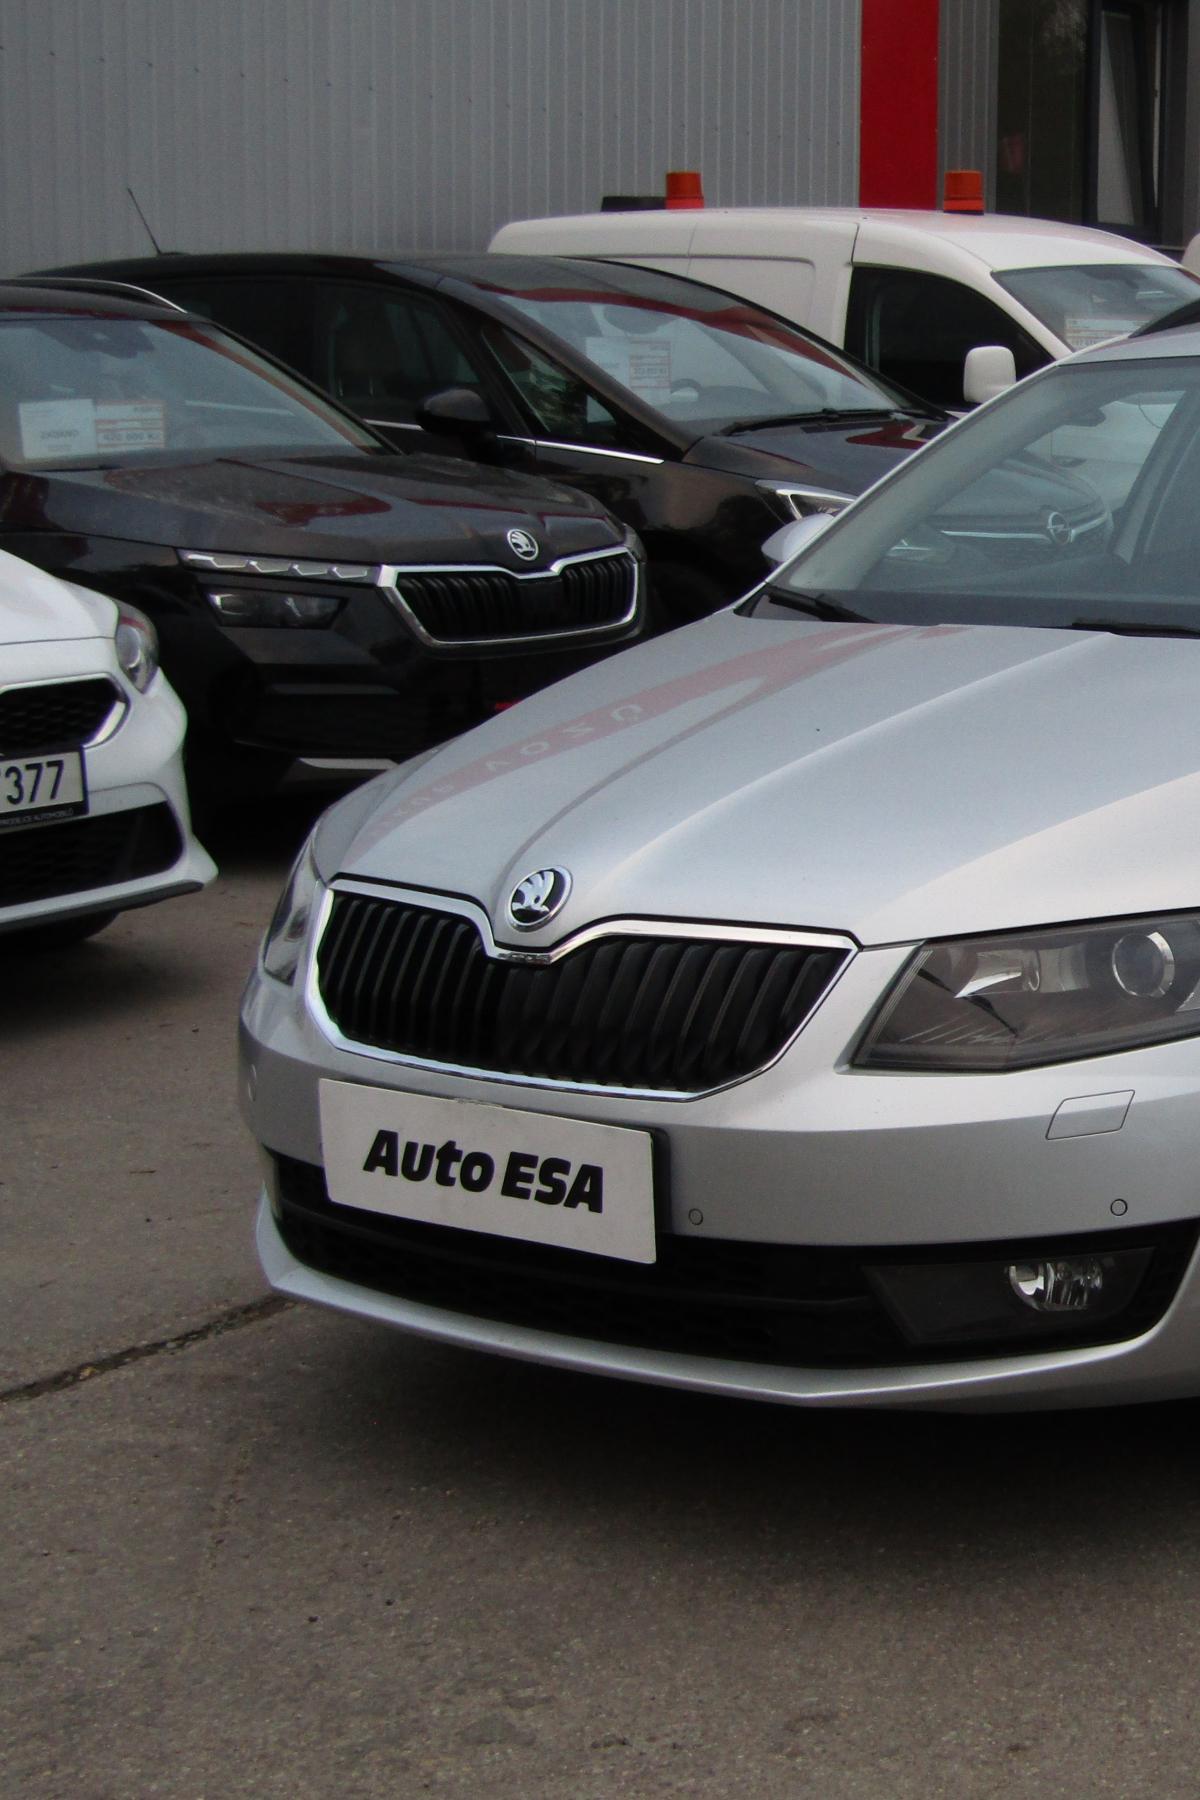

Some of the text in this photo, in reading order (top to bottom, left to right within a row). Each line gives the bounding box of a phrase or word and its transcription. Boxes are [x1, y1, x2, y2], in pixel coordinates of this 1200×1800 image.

[0, 760, 65, 806] 377
[362, 1129, 603, 1214] Auto ESA
